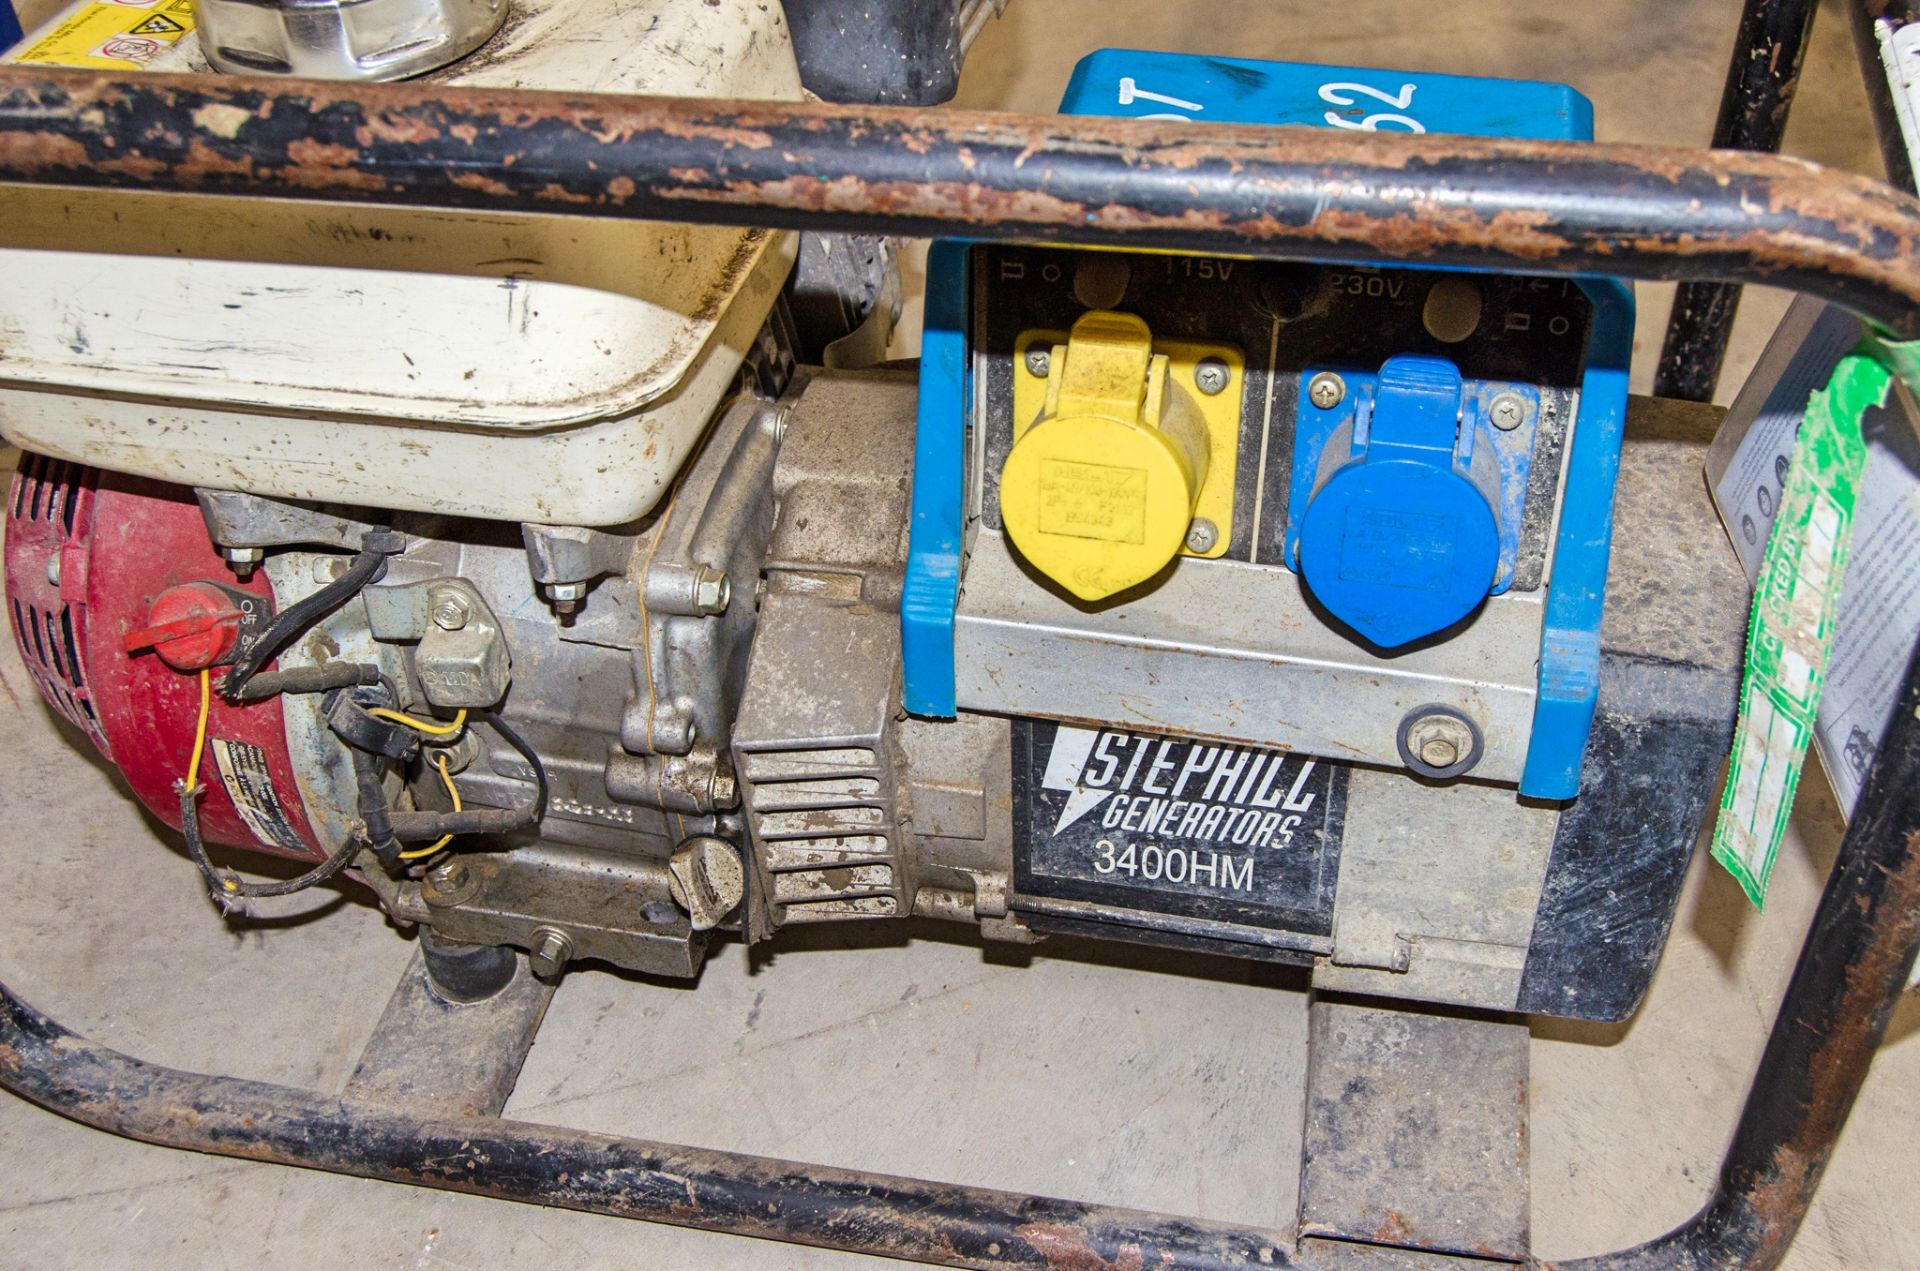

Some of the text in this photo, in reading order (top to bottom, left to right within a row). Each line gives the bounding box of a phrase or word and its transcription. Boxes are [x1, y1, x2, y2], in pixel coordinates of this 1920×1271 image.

[1162, 257, 1235, 282] 115V
[1328, 273, 1404, 299] 230V
[241, 613, 258, 625] OFF
[1084, 730, 1319, 813] STEPHILL
[1101, 793, 1302, 850] GENERATORS
[1093, 839, 1255, 892] 3400HM
